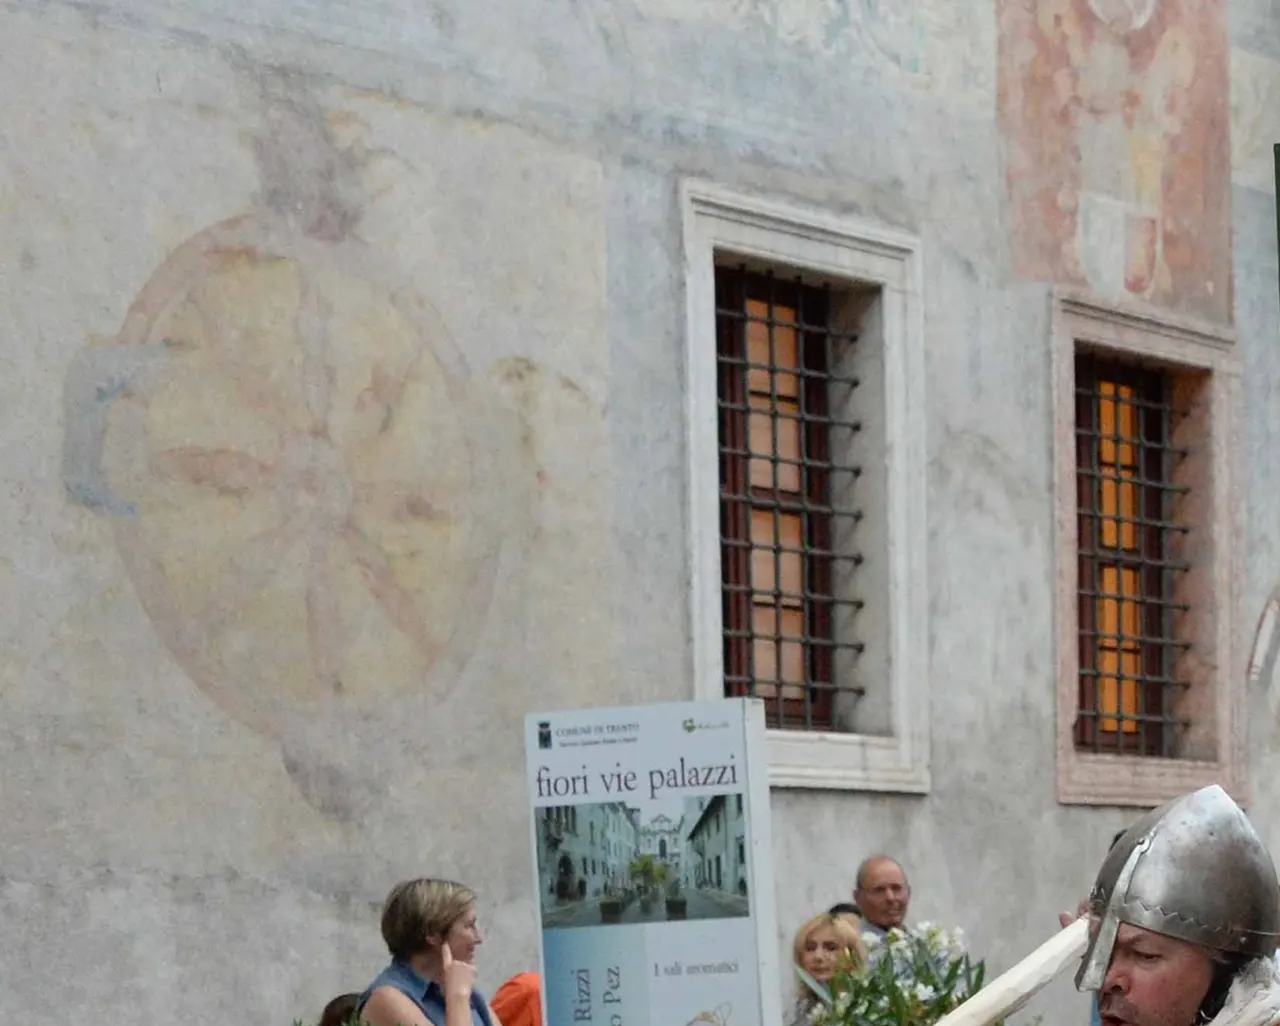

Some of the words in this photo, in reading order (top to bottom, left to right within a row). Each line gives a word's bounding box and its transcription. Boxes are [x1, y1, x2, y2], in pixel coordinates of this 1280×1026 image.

[536, 764, 590, 798] fiori
[600, 762, 637, 794] vie
[649, 754, 737, 800] palazzi
[571, 969, 592, 1022] Rizzi
[603, 966, 621, 1004] Pez
